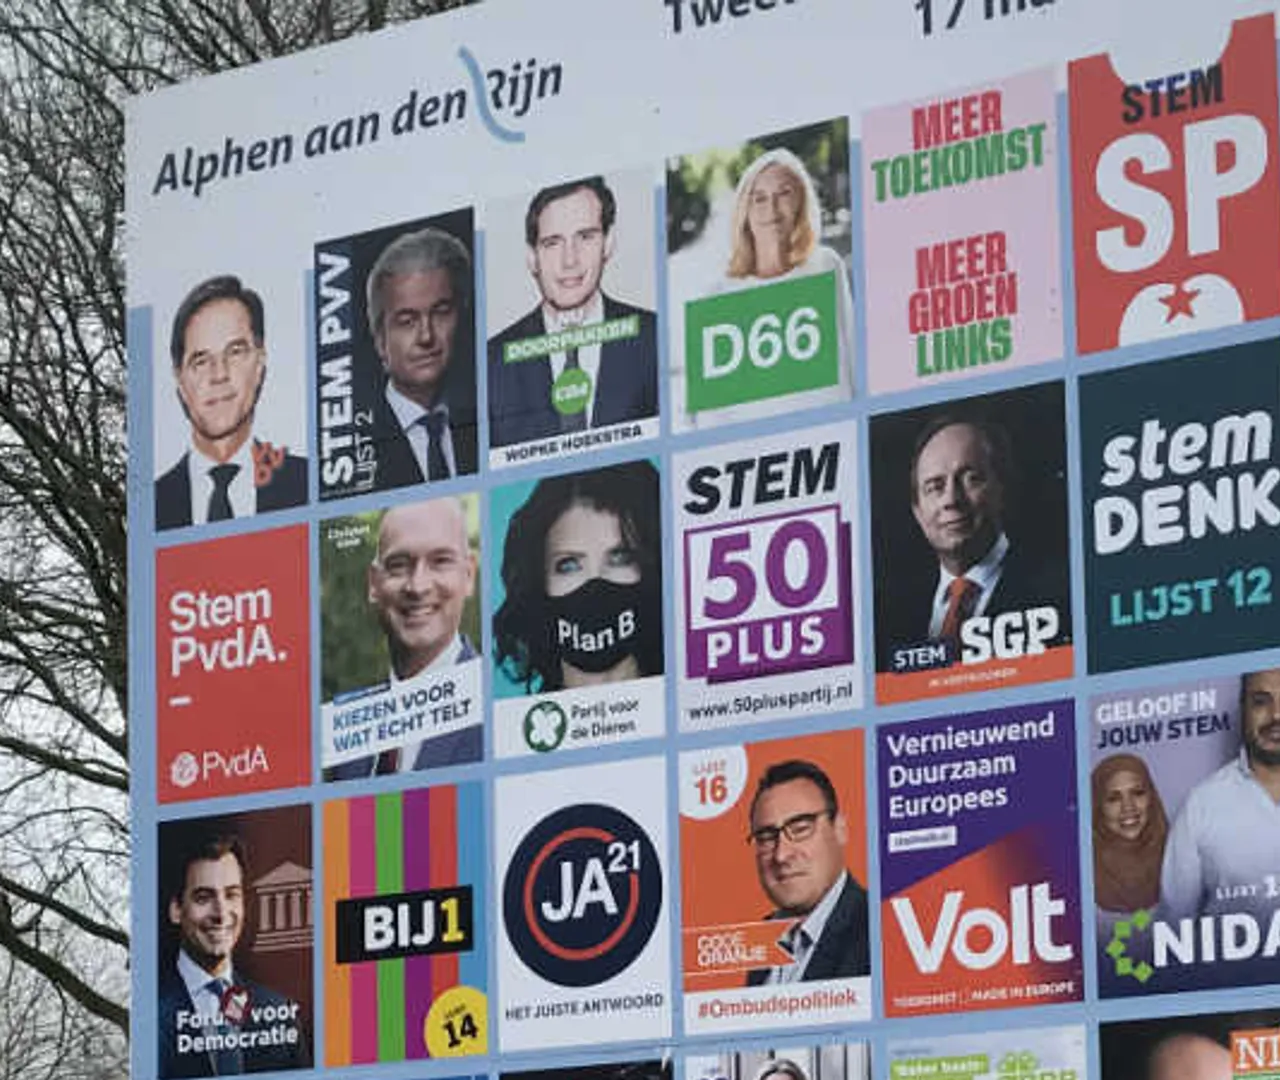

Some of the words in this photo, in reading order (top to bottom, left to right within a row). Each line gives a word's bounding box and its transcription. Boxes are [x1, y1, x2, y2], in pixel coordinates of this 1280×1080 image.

[1121, 64, 1224, 123] STEM
[153, 134, 293, 196] Alphen
[304, 111, 379, 159] aan
[391, 88, 467, 136] den
[464, 50, 564, 124] Rijn
[911, 90, 1004, 151] MEER
[871, 123, 1046, 201] TOEKOMST
[1095, 115, 1268, 273] SP
[915, 230, 1007, 290] MEER
[318, 252, 352, 346] PVV
[907, 271, 1018, 335] GROEN
[701, 306, 820, 379] D66
[916, 319, 1013, 376] LINKS
[321, 354, 354, 486] STEM
[355, 411, 373, 426] 2
[505, 443, 559, 462] WOPKE
[561, 425, 642, 450] HOEKSTRA
[1101, 410, 1272, 487] stem
[684, 442, 840, 515] STEM
[703, 520, 828, 620] 50
[170, 588, 272, 632] Stem
[1111, 578, 1218, 626] LIJST
[1227, 566, 1272, 607] 12
[171, 624, 287, 677] PvdA.
[558, 618, 614, 651] Plan
[618, 610, 635, 639] B
[707, 616, 825, 668] PLUS
[894, 644, 946, 668] STEM
[961, 606, 1059, 666] SGP
[332, 724, 373, 752] WAT
[377, 711, 426, 740] ECHT
[432, 699, 472, 725] TELT
[333, 694, 396, 731] KIEZEN
[402, 680, 455, 710] VOOR
[571, 700, 606, 719] Partij
[609, 699, 639, 712] voor
[689, 682, 852, 720] www.50pluspartij.nl
[1096, 692, 1188, 724] GELOOF
[1191, 689, 1217, 711] IN
[572, 726, 589, 739] de
[592, 720, 636, 737] Dieren
[887, 711, 1055, 757] Vernieuwend
[1097, 721, 1163, 750] JOUW
[1168, 713, 1231, 740] STEM
[202, 745, 269, 781] PvdA
[888, 754, 1016, 788] Duurzaam
[695, 776, 728, 804] 16
[889, 785, 1008, 819] Europees
[364, 897, 465, 951] BIJ1
[890, 882, 1074, 975] Volt
[697, 946, 767, 967] ORANJE
[251, 1003, 299, 1022] voor
[506, 1003, 531, 1021] HET
[533, 1001, 577, 1019] JUISTE
[582, 993, 664, 1015] ANTWOORD
[698, 988, 857, 1019] #Ombudspolitiek
[971, 986, 1007, 1001] MADE
[1010, 987, 1023, 998] IN
[1026, 981, 1075, 998] EUROPE
[178, 1024, 299, 1053] Democratie
[442, 1013, 479, 1049] 14
